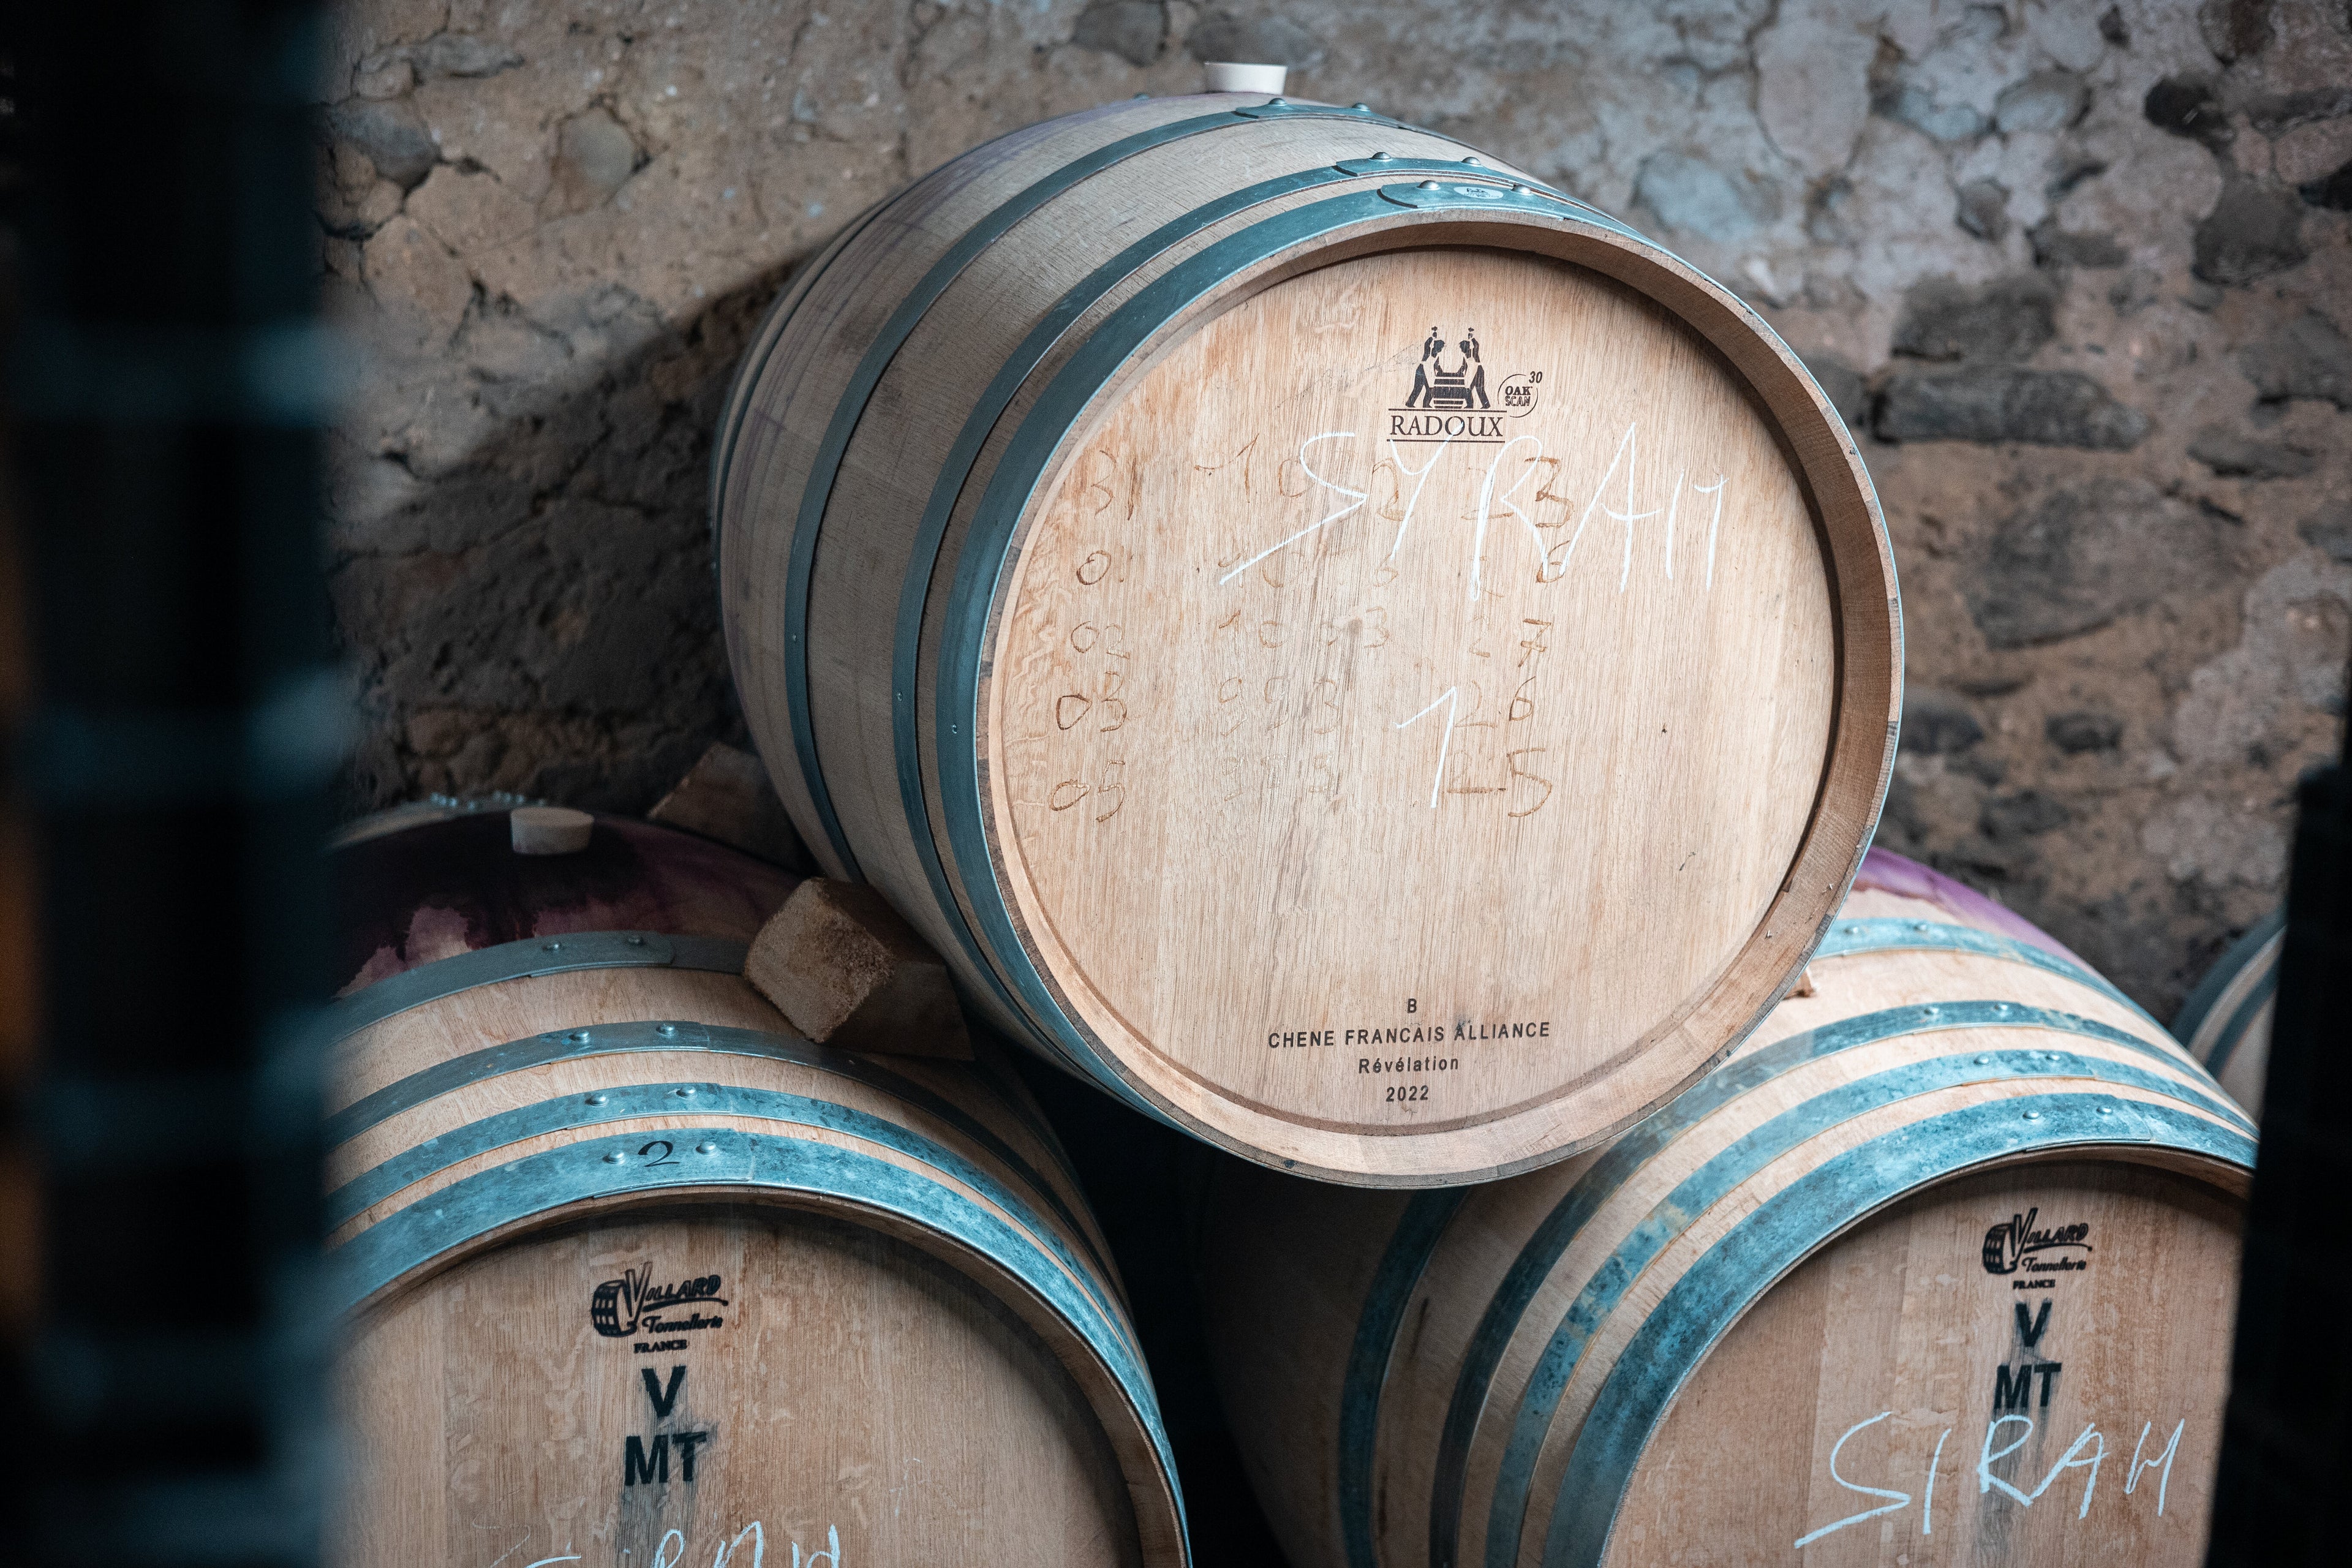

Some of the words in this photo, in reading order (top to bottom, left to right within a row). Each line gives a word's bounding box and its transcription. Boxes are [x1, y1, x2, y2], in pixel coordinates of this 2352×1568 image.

[1528, 371, 1543, 384] 30
[1504, 396, 1531, 407] SCAN
[1505, 385, 1531, 396] OAK
[1389, 415, 1503, 437] RADOUX
[1406, 998, 1417, 1014] B
[1268, 1030, 1335, 1049] CHENE
[1344, 1025, 1445, 1046] FRANCAIS
[1453, 1021, 1551, 1041] ALLIANCE
[1358, 1057, 1460, 1074] Révélation
[1385, 1085, 1430, 1102] 2022
[638, 1140, 680, 1167] 2
[2012, 1207, 2089, 1257] VILLARD
[624, 1261, 722, 1317] VILLARD
[2013, 1279, 2056, 1290] FRANCE
[2015, 1299, 2052, 1348] V
[633, 1339, 687, 1354] FRANCE
[641, 1364, 687, 1418] V
[1994, 1362, 2062, 1410] MT
[624, 1430, 707, 1487] MT
